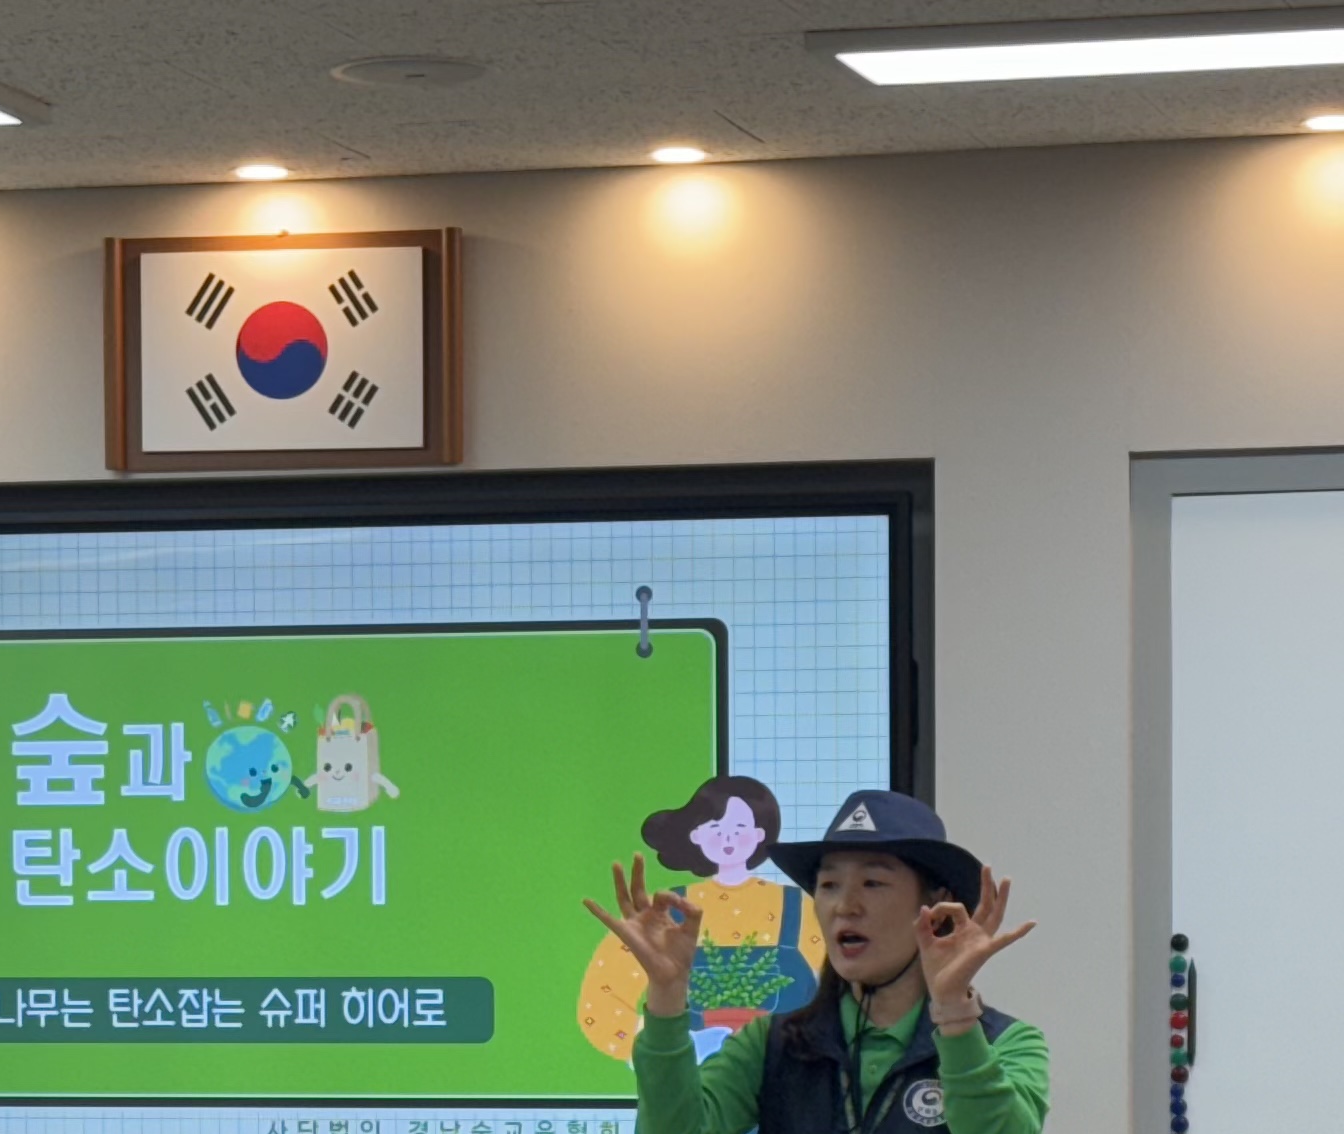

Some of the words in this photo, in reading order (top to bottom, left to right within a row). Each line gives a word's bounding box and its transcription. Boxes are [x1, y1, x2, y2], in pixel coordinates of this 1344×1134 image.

[11, 693, 192, 805] 숲과
[12, 825, 386, 906] 탄소이야기
[108, 987, 246, 1029] 탄소잡는
[258, 987, 327, 1028] 슈퍼
[341, 986, 447, 1028] 히어로
